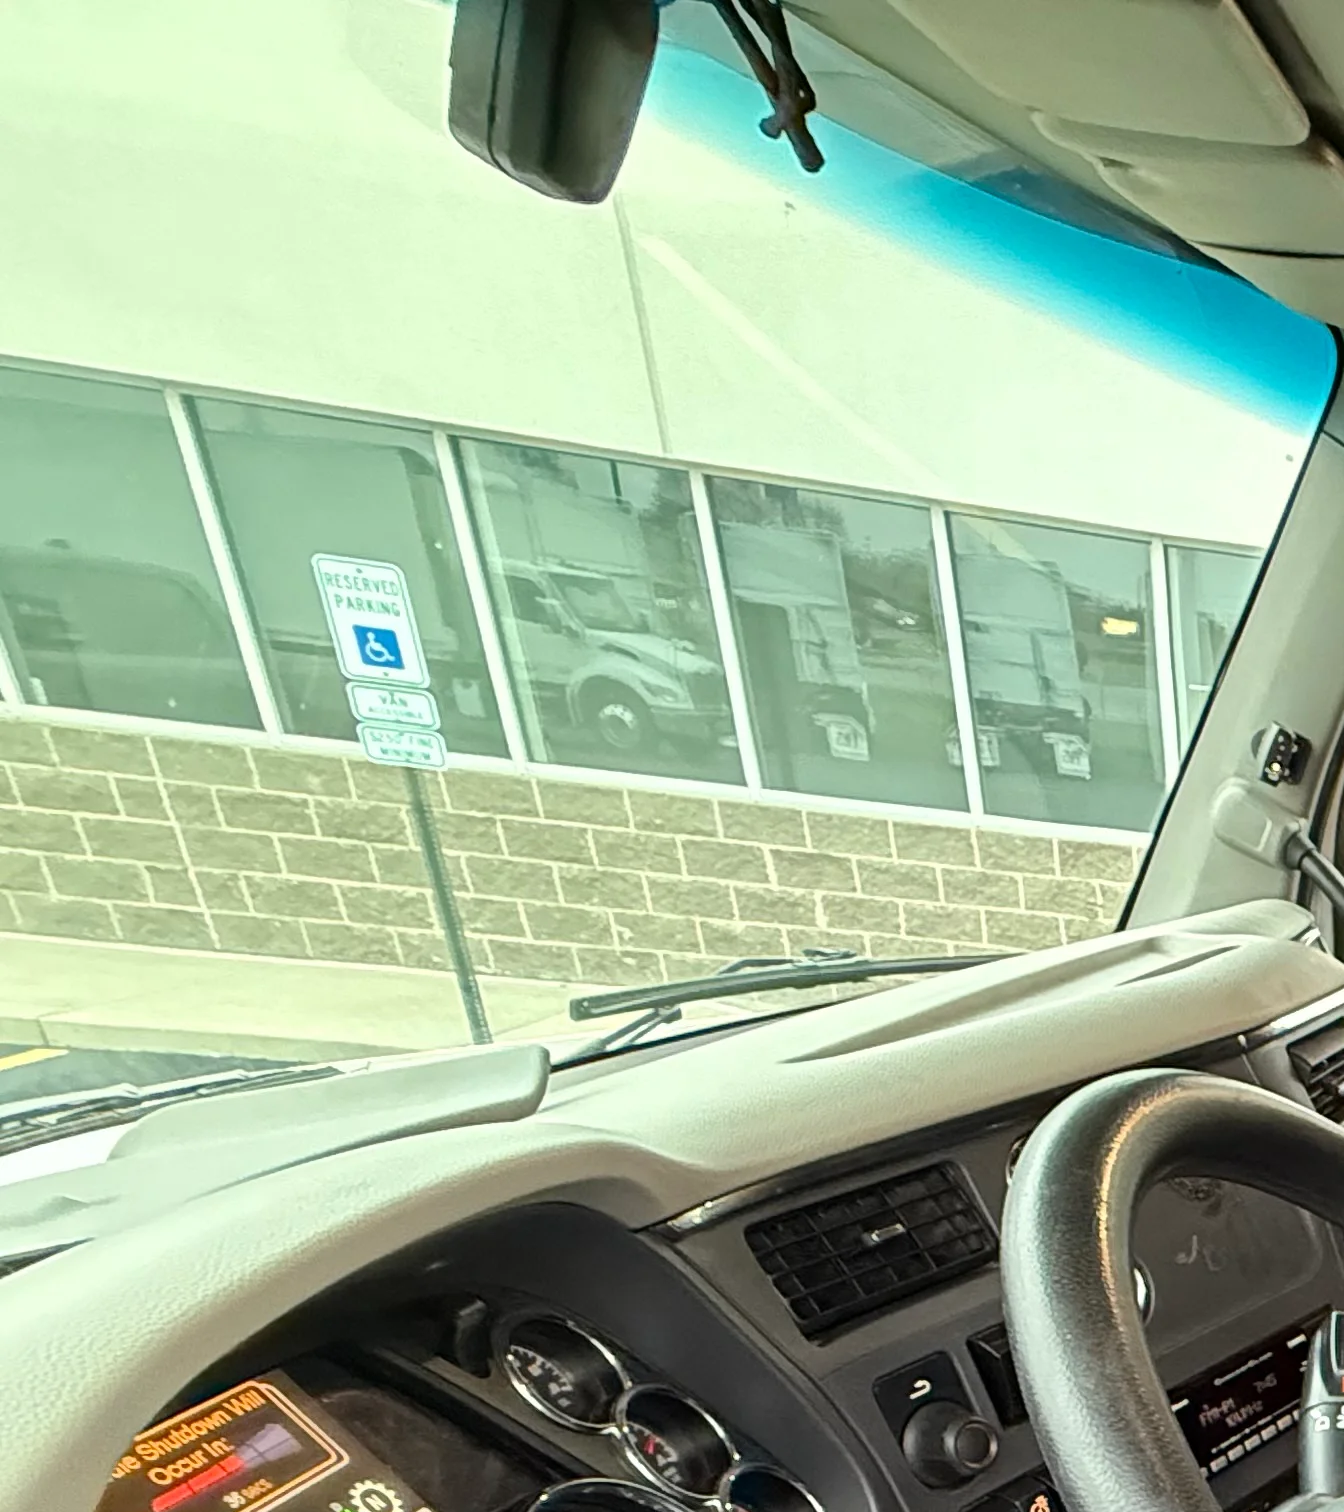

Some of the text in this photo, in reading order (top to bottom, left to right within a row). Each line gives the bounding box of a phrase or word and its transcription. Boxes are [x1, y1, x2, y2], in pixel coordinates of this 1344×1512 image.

[323, 572, 400, 597] RESERVED
[333, 594, 401, 617] PARKING
[378, 693, 408, 708] VAN
[134, 1408, 232, 1462] Shutdown
[223, 1389, 267, 1416] Will
[1315, 1416, 1330, 1432] D
[147, 1437, 236, 1485] Occur In:
[363, 1493, 386, 1511] N
